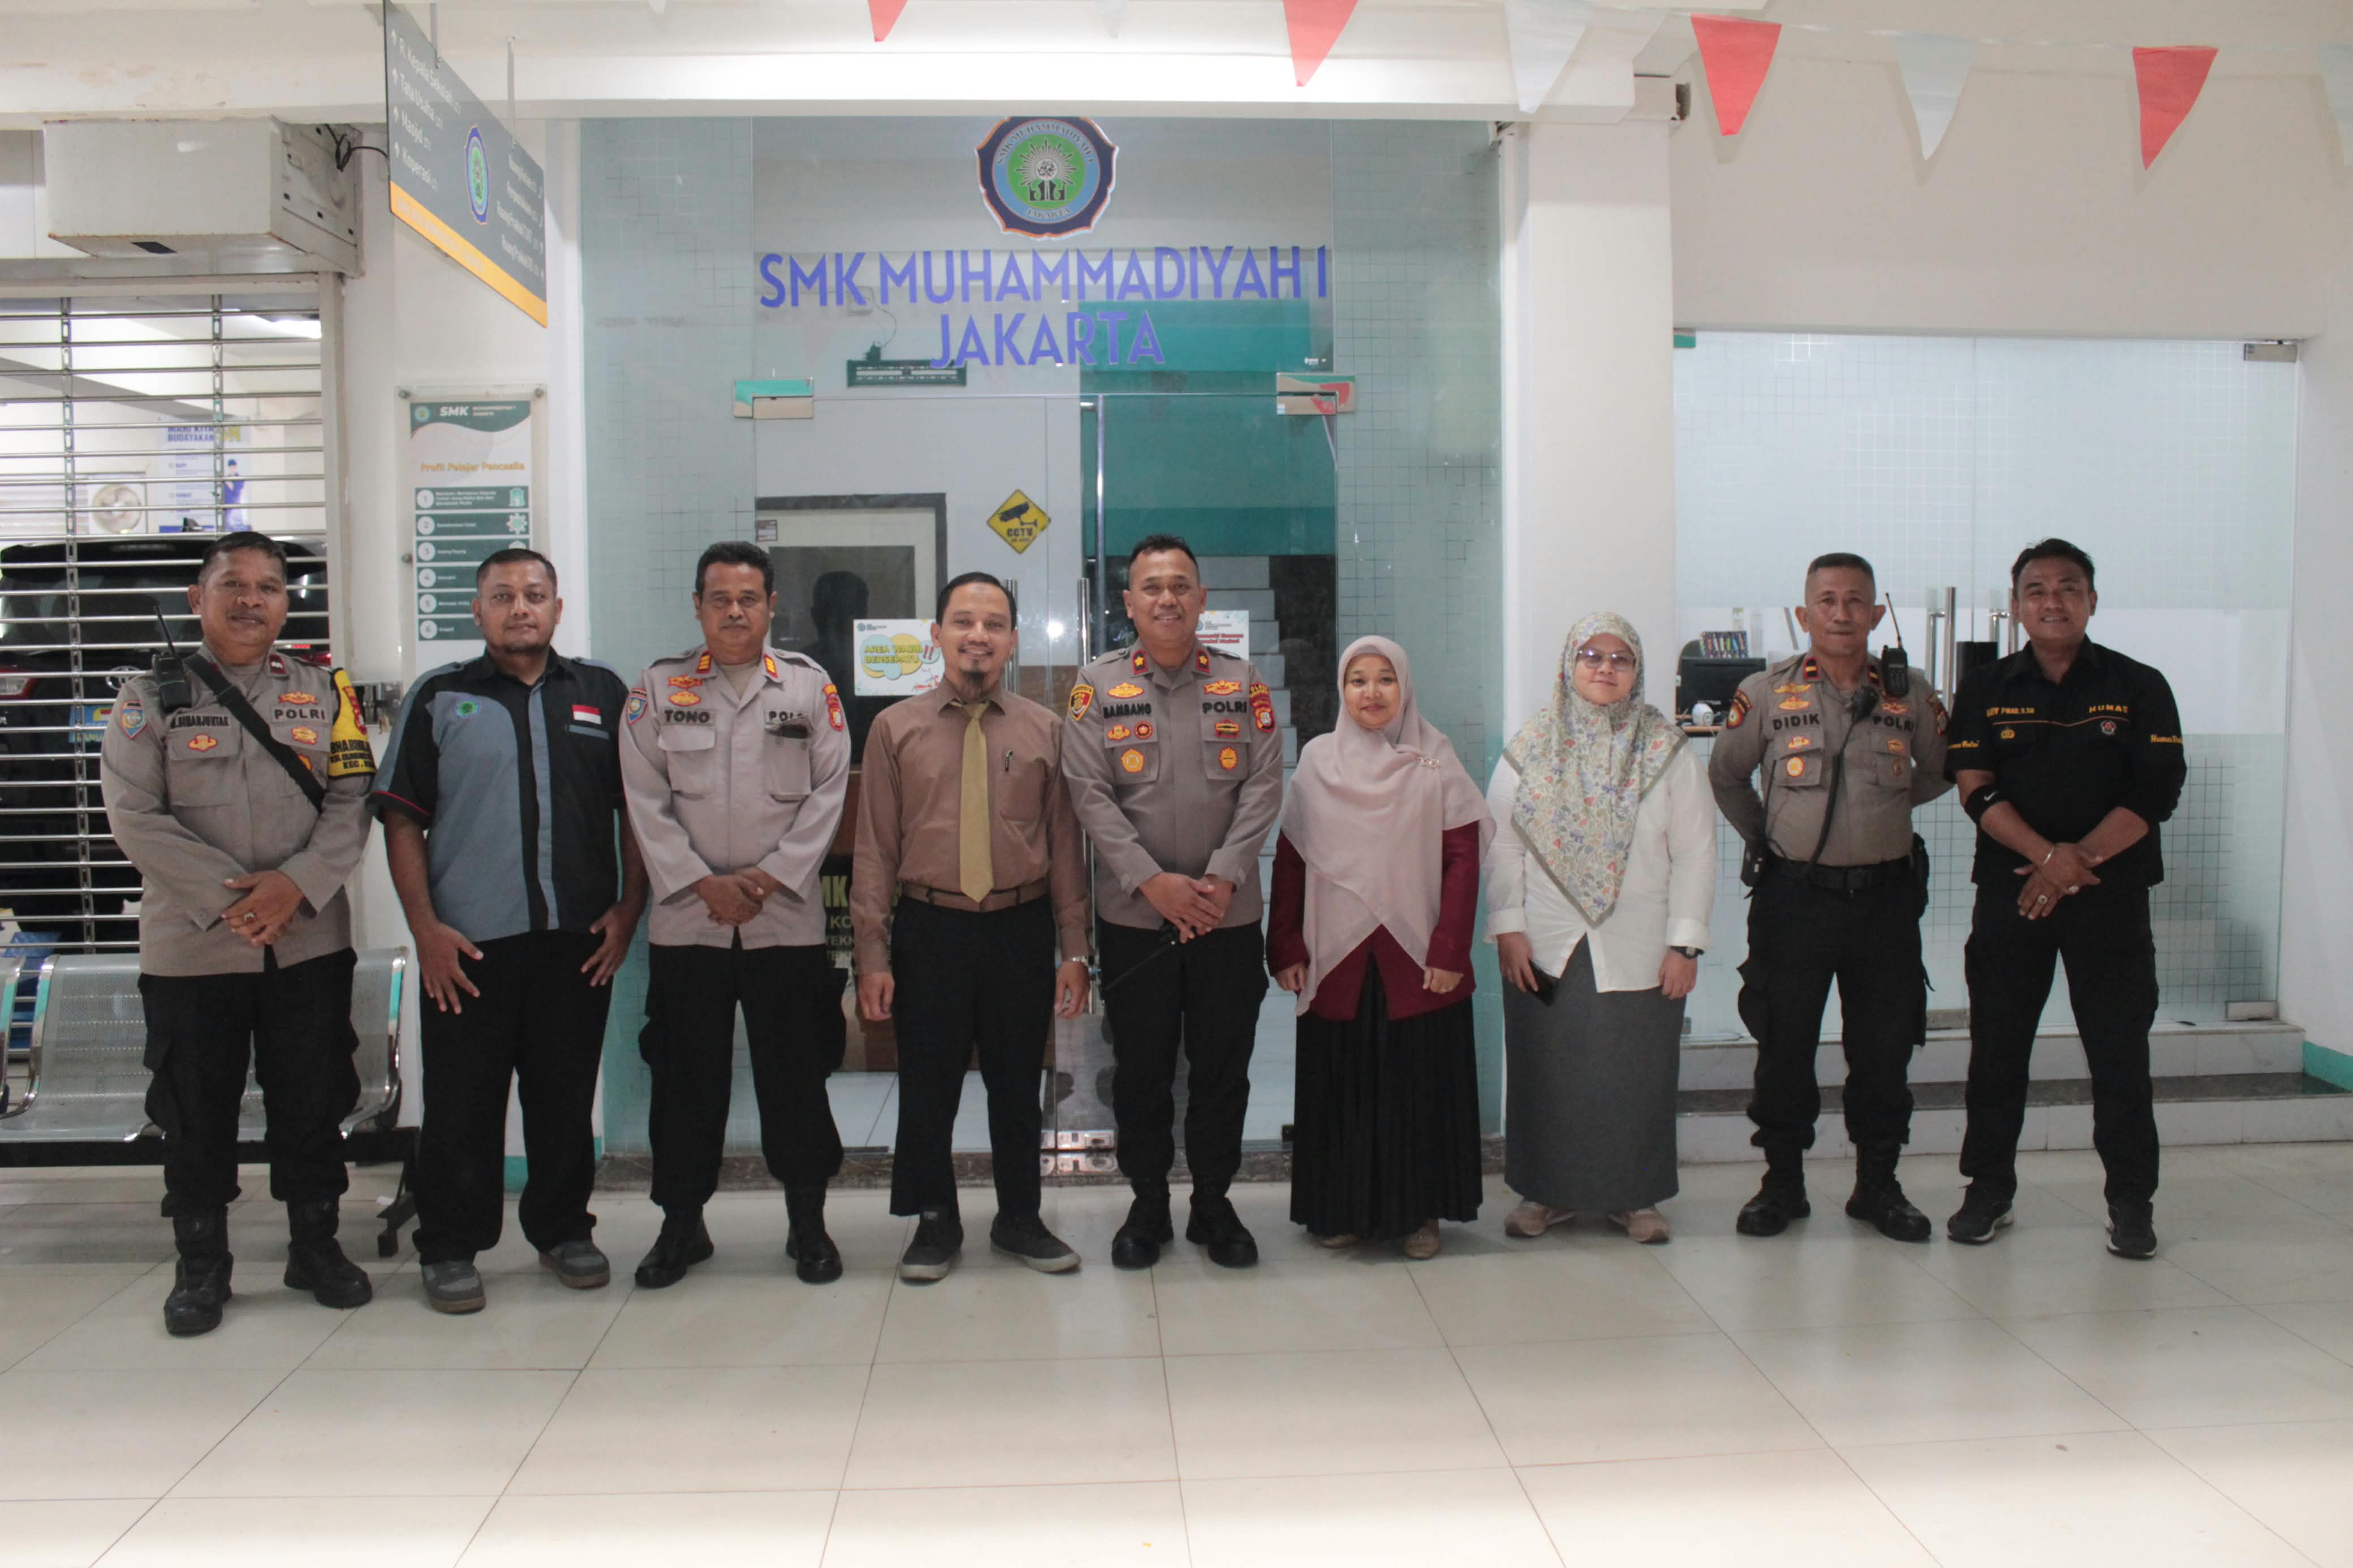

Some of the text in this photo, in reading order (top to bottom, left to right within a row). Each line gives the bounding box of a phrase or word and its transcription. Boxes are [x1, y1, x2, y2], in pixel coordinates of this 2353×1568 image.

[1026, 207, 1072, 219] JAKARTA
[759, 244, 1326, 308] SMK MUHAMMADIYAH 1
[929, 310, 1165, 369] JAKARTA
[439, 406, 469, 417] SMK
[447, 462, 480, 473] Pelajar
[1007, 528, 1032, 537] CCTV
[894, 645, 923, 653] WAJIB
[864, 655, 920, 664] BERSEPATU
[1104, 703, 1152, 719] BAMBANG
[1203, 701, 1247, 714] POLRI
[2089, 704, 2128, 714] HUMAS
[275, 709, 325, 719] POLRI
[665, 710, 710, 723] TONO
[1773, 714, 1820, 730] DIDIK
[1873, 715, 1914, 733] POLRI
